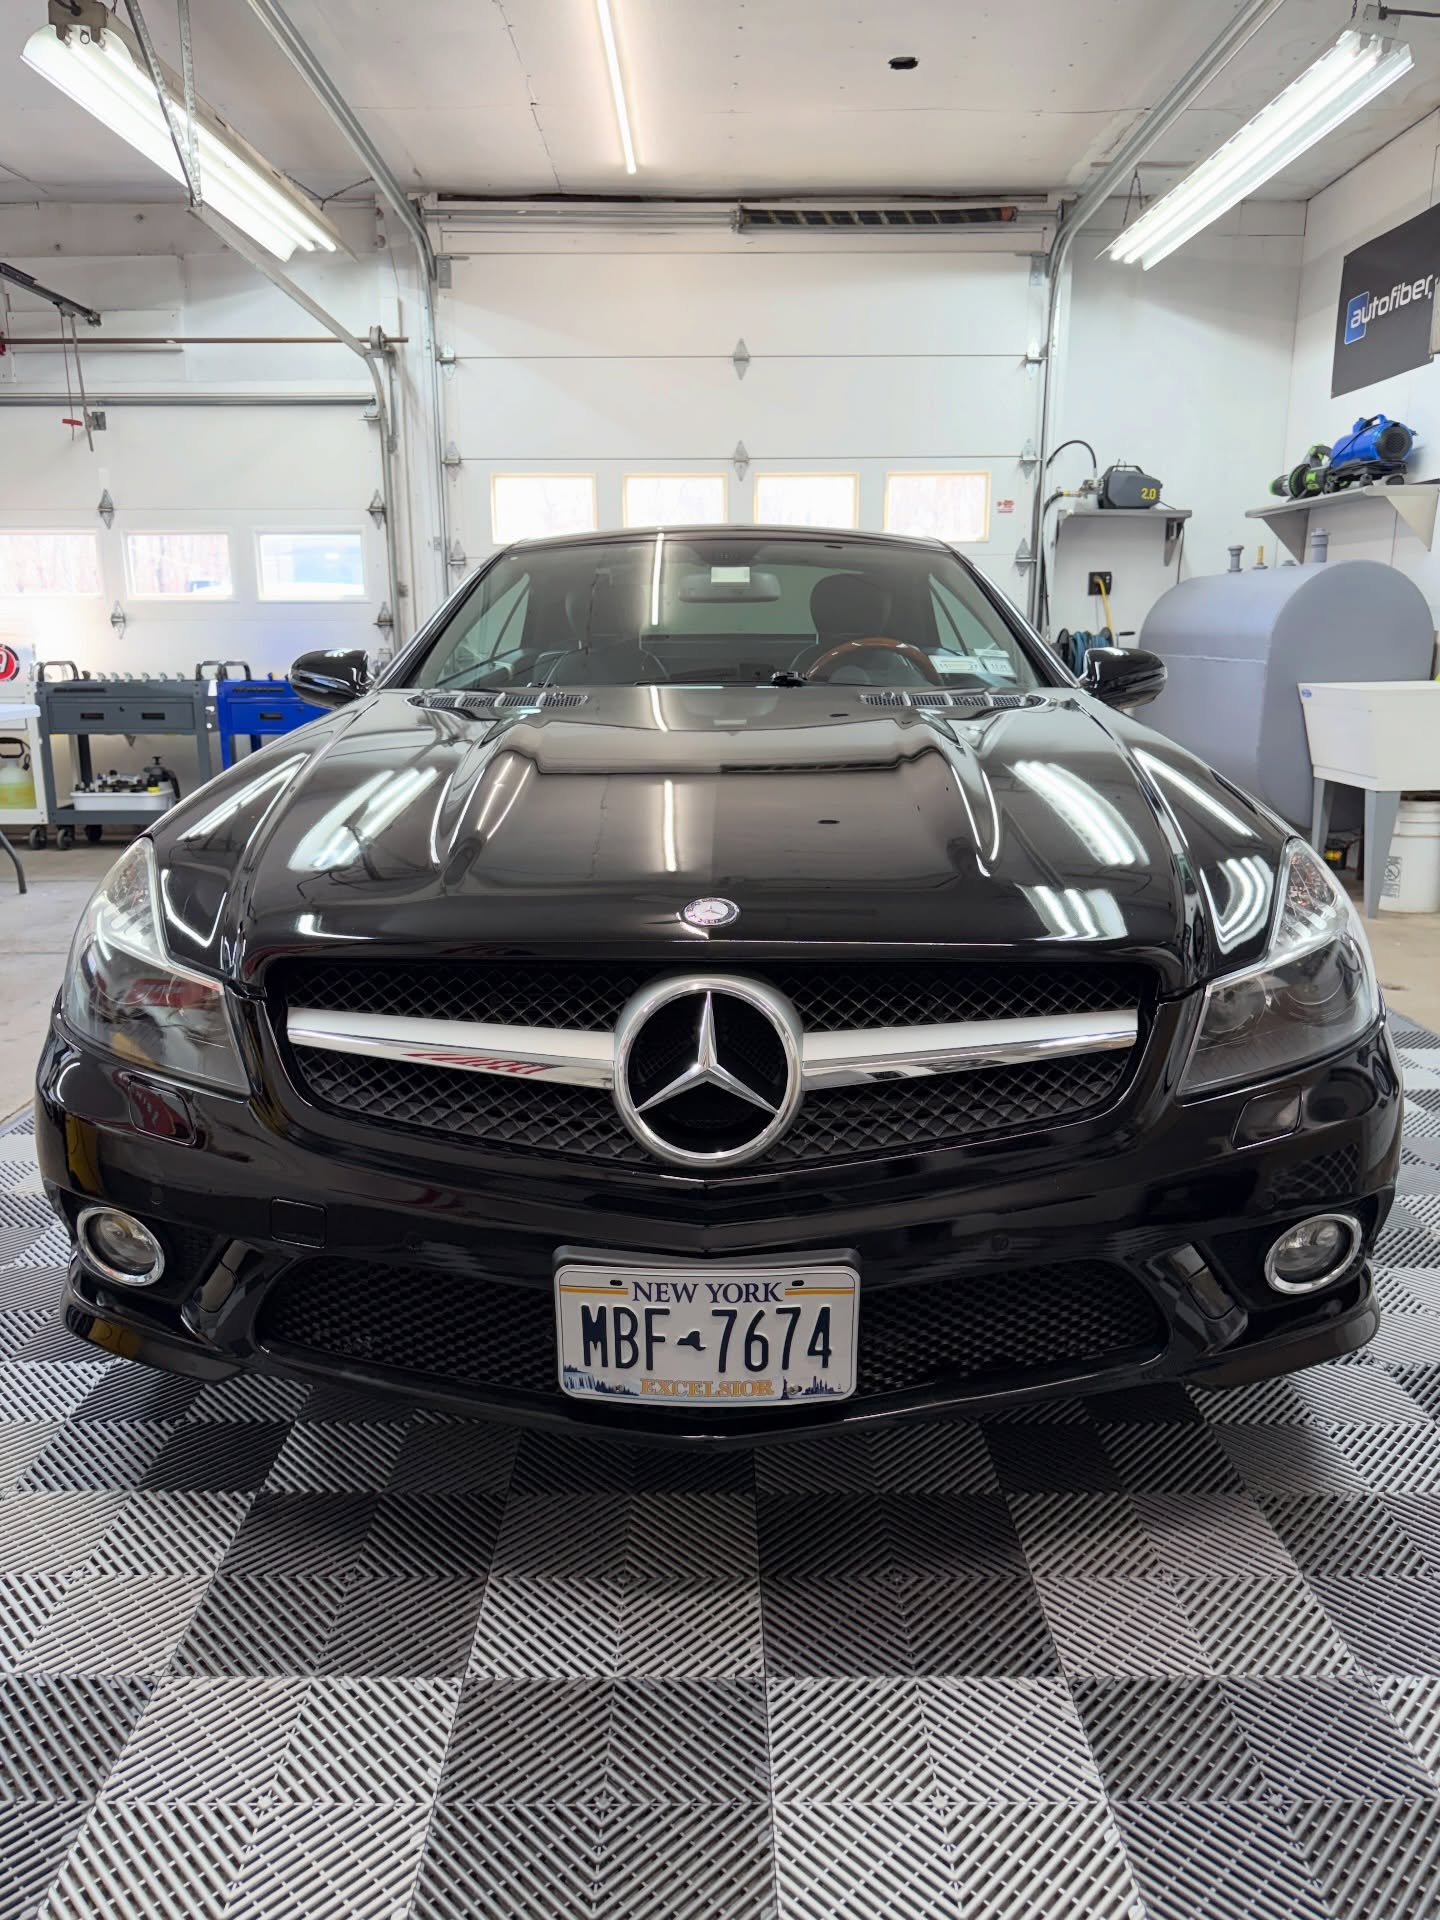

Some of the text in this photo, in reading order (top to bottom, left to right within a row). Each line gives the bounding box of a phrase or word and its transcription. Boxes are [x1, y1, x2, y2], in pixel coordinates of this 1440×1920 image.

[1350, 274, 1433, 328] autofiber
[1141, 487, 1156, 500] 2.0
[632, 1281, 784, 1304] NEW YORK
[580, 1304, 832, 1373] MBF 7674
[640, 1378, 774, 1397] EXCELSIOR
